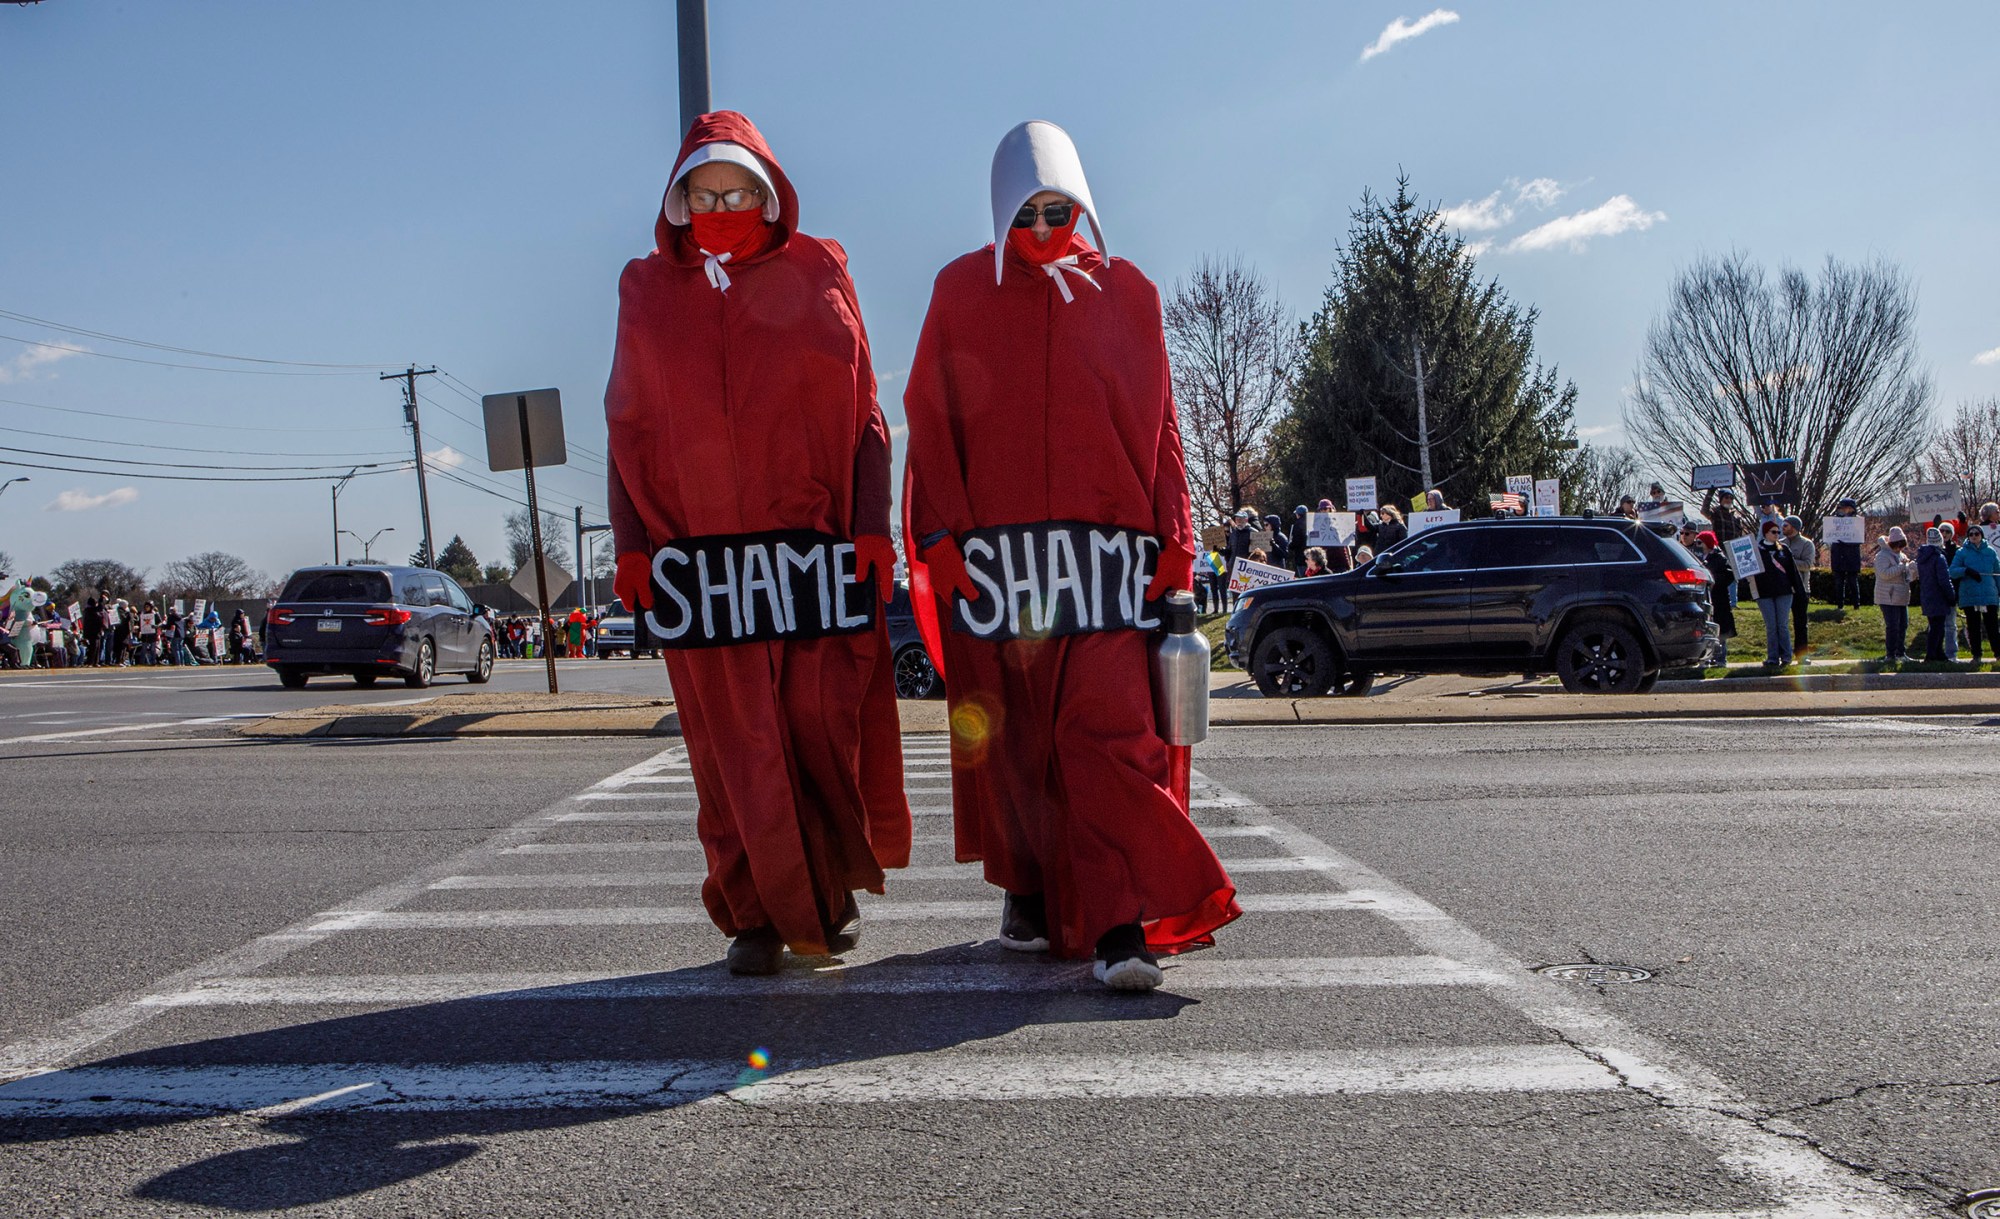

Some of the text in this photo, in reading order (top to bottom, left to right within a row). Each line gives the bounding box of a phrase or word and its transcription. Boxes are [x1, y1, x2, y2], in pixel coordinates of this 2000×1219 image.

[1508, 477, 1532, 485] FAUX
[1510, 485, 1532, 493] KING
[1425, 515, 1444, 523] LET'S
[1237, 560, 1290, 582] Democracy
[959, 529, 1162, 636] SHAME
[644, 542, 869, 640] SHAME
